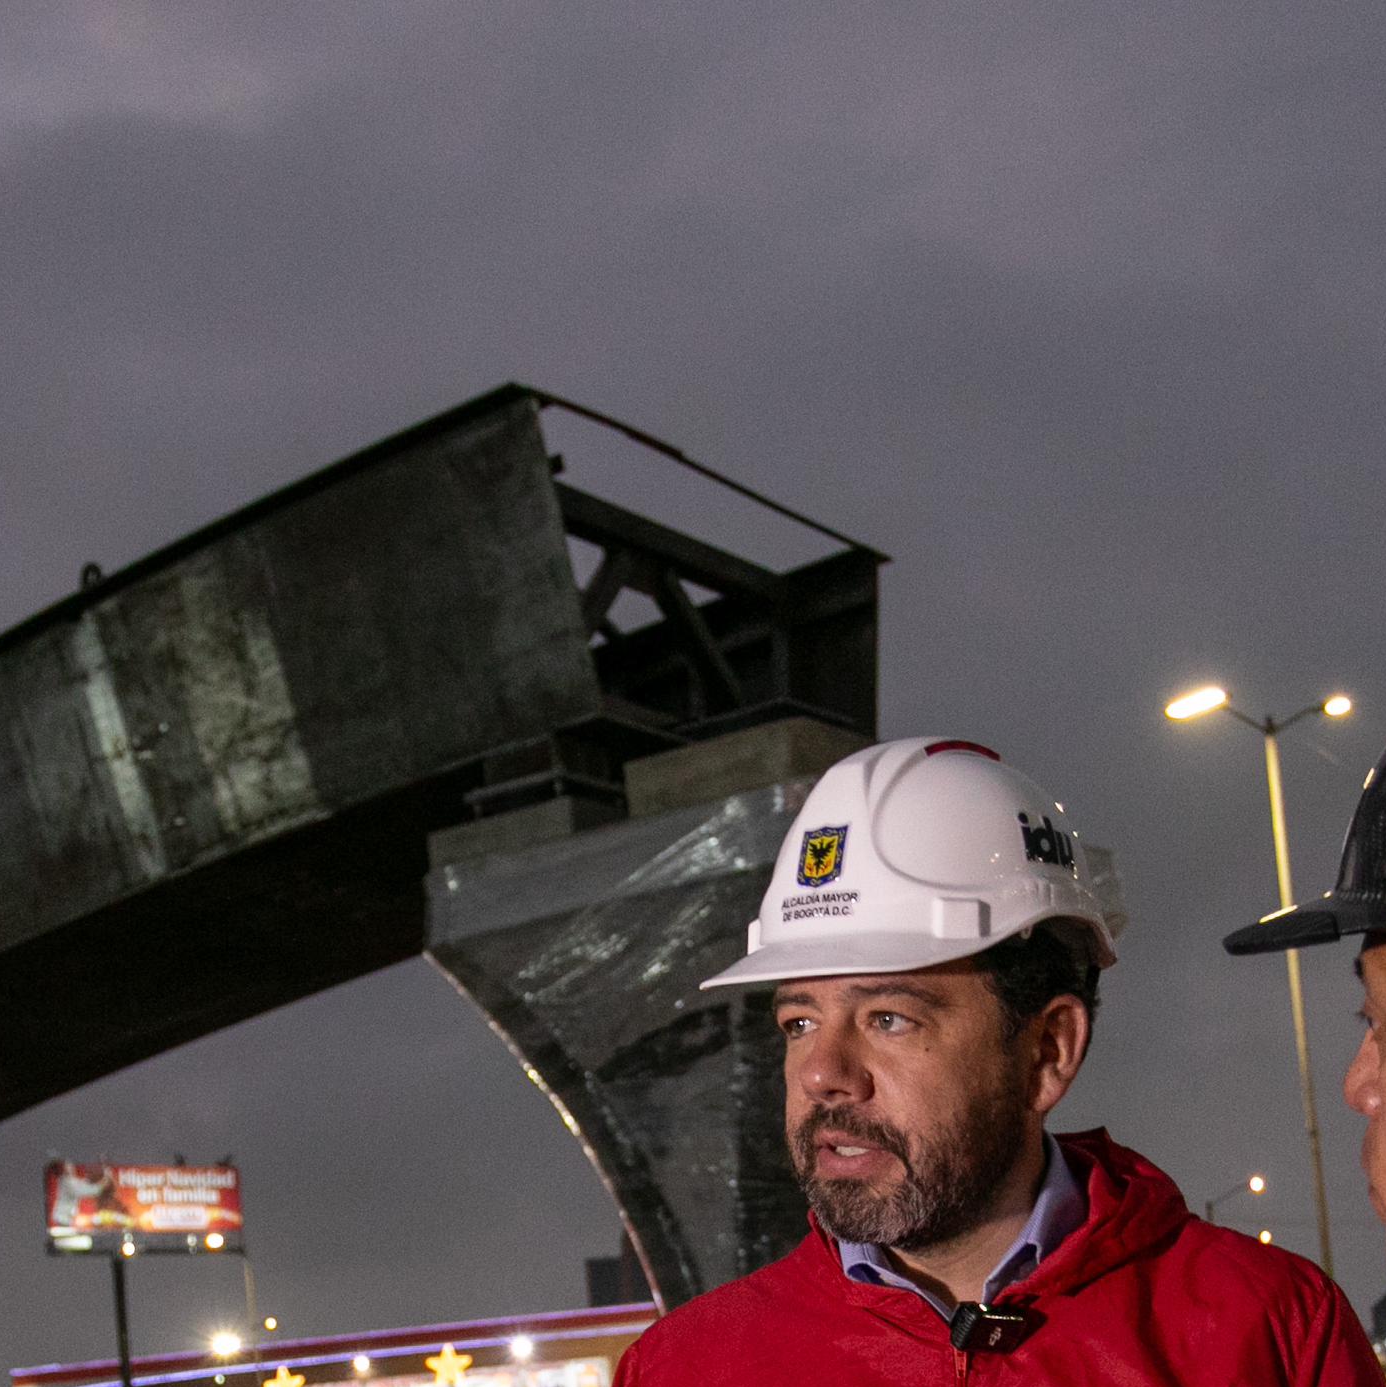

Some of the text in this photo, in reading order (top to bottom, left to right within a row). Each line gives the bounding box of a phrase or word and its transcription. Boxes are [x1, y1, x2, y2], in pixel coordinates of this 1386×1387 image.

[1018, 812, 1075, 870] idu
[822, 892, 859, 903] MAYOR
[782, 912, 792, 922] DE
[167, 1168, 236, 1188] Navidad
